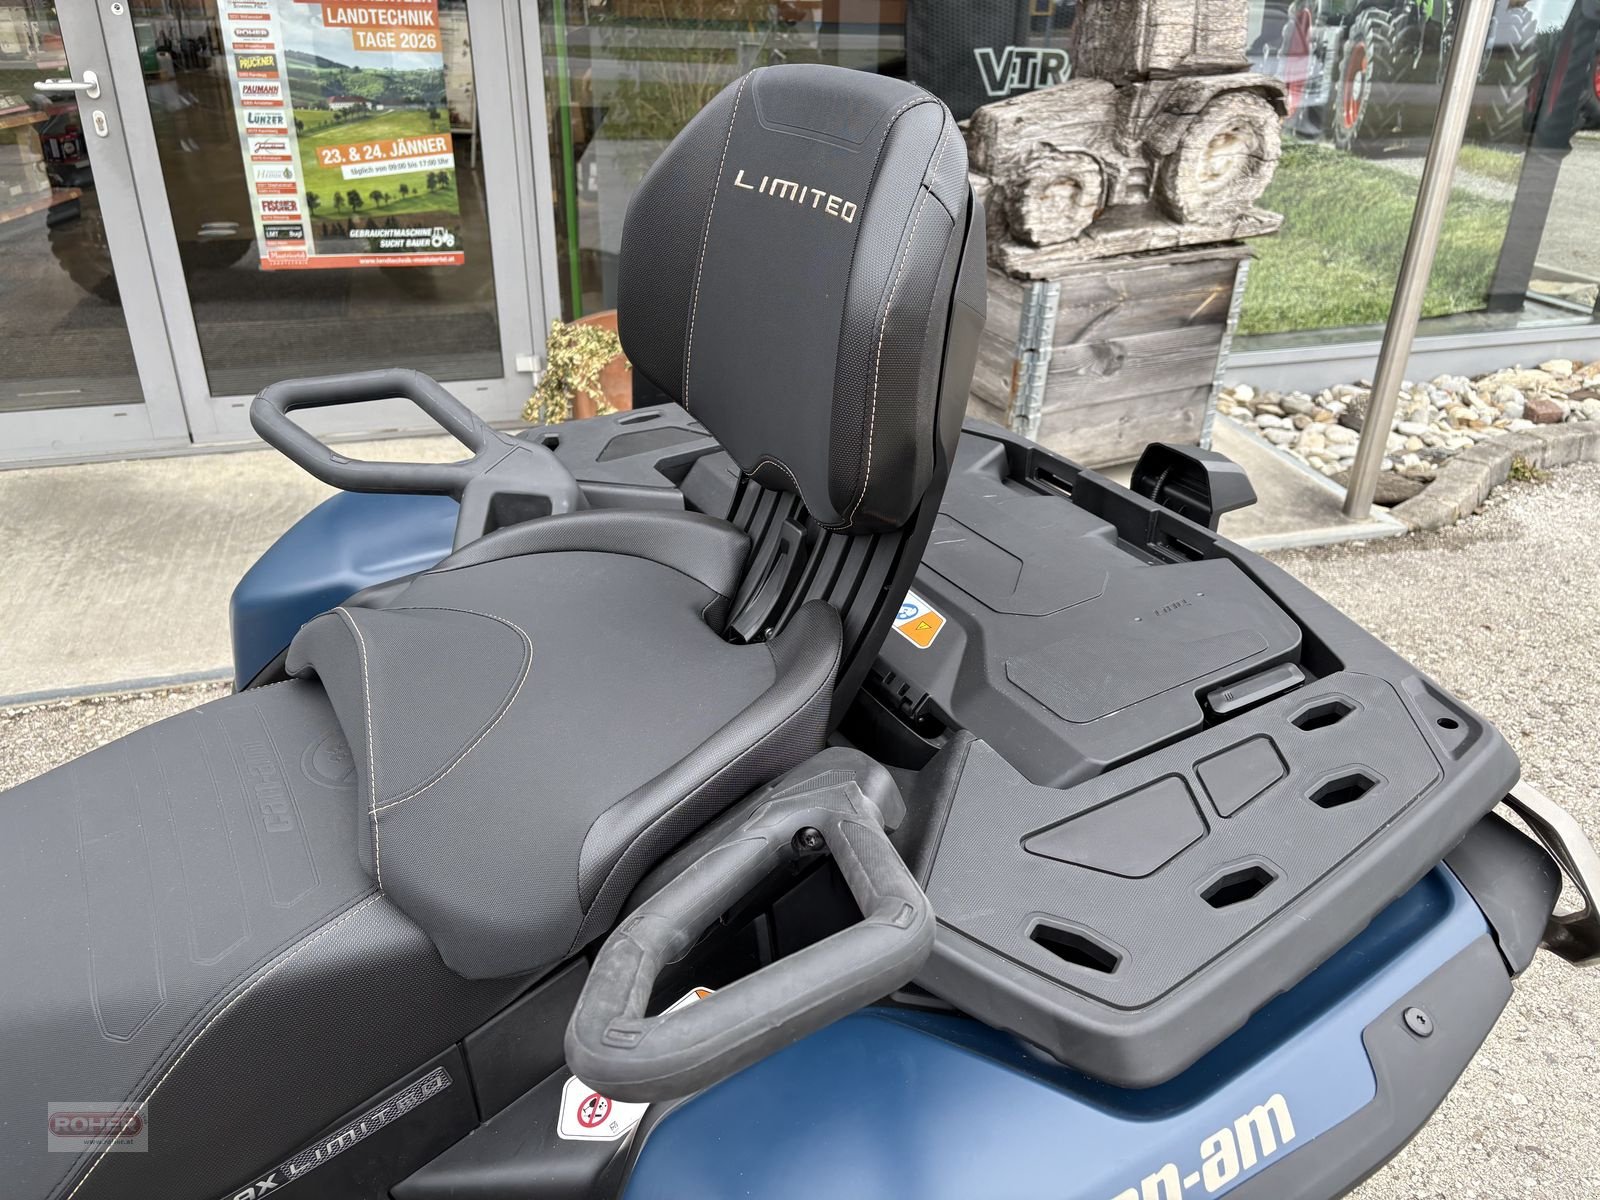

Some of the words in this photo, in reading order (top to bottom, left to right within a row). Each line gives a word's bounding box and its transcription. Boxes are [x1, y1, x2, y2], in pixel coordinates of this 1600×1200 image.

[326, 7, 435, 26] LANDTECHNIK
[356, 31, 397, 48] TAGE
[399, 32, 437, 49] 2026
[242, 85, 280, 95] PAUMANN
[321, 148, 346, 164] 23.
[348, 147, 361, 161] &
[363, 144, 387, 160] 24.
[389, 137, 448, 157] JÄNNER
[734, 169, 858, 224] LIMITED
[349, 228, 432, 238] GEBRAUCHTMASCHINE
[380, 239, 405, 248] SUCHT
[405, 238, 431, 247] BAUER
[289, 1075, 443, 1175] LIMITED
[1110, 1093, 1296, 1200] n-am
